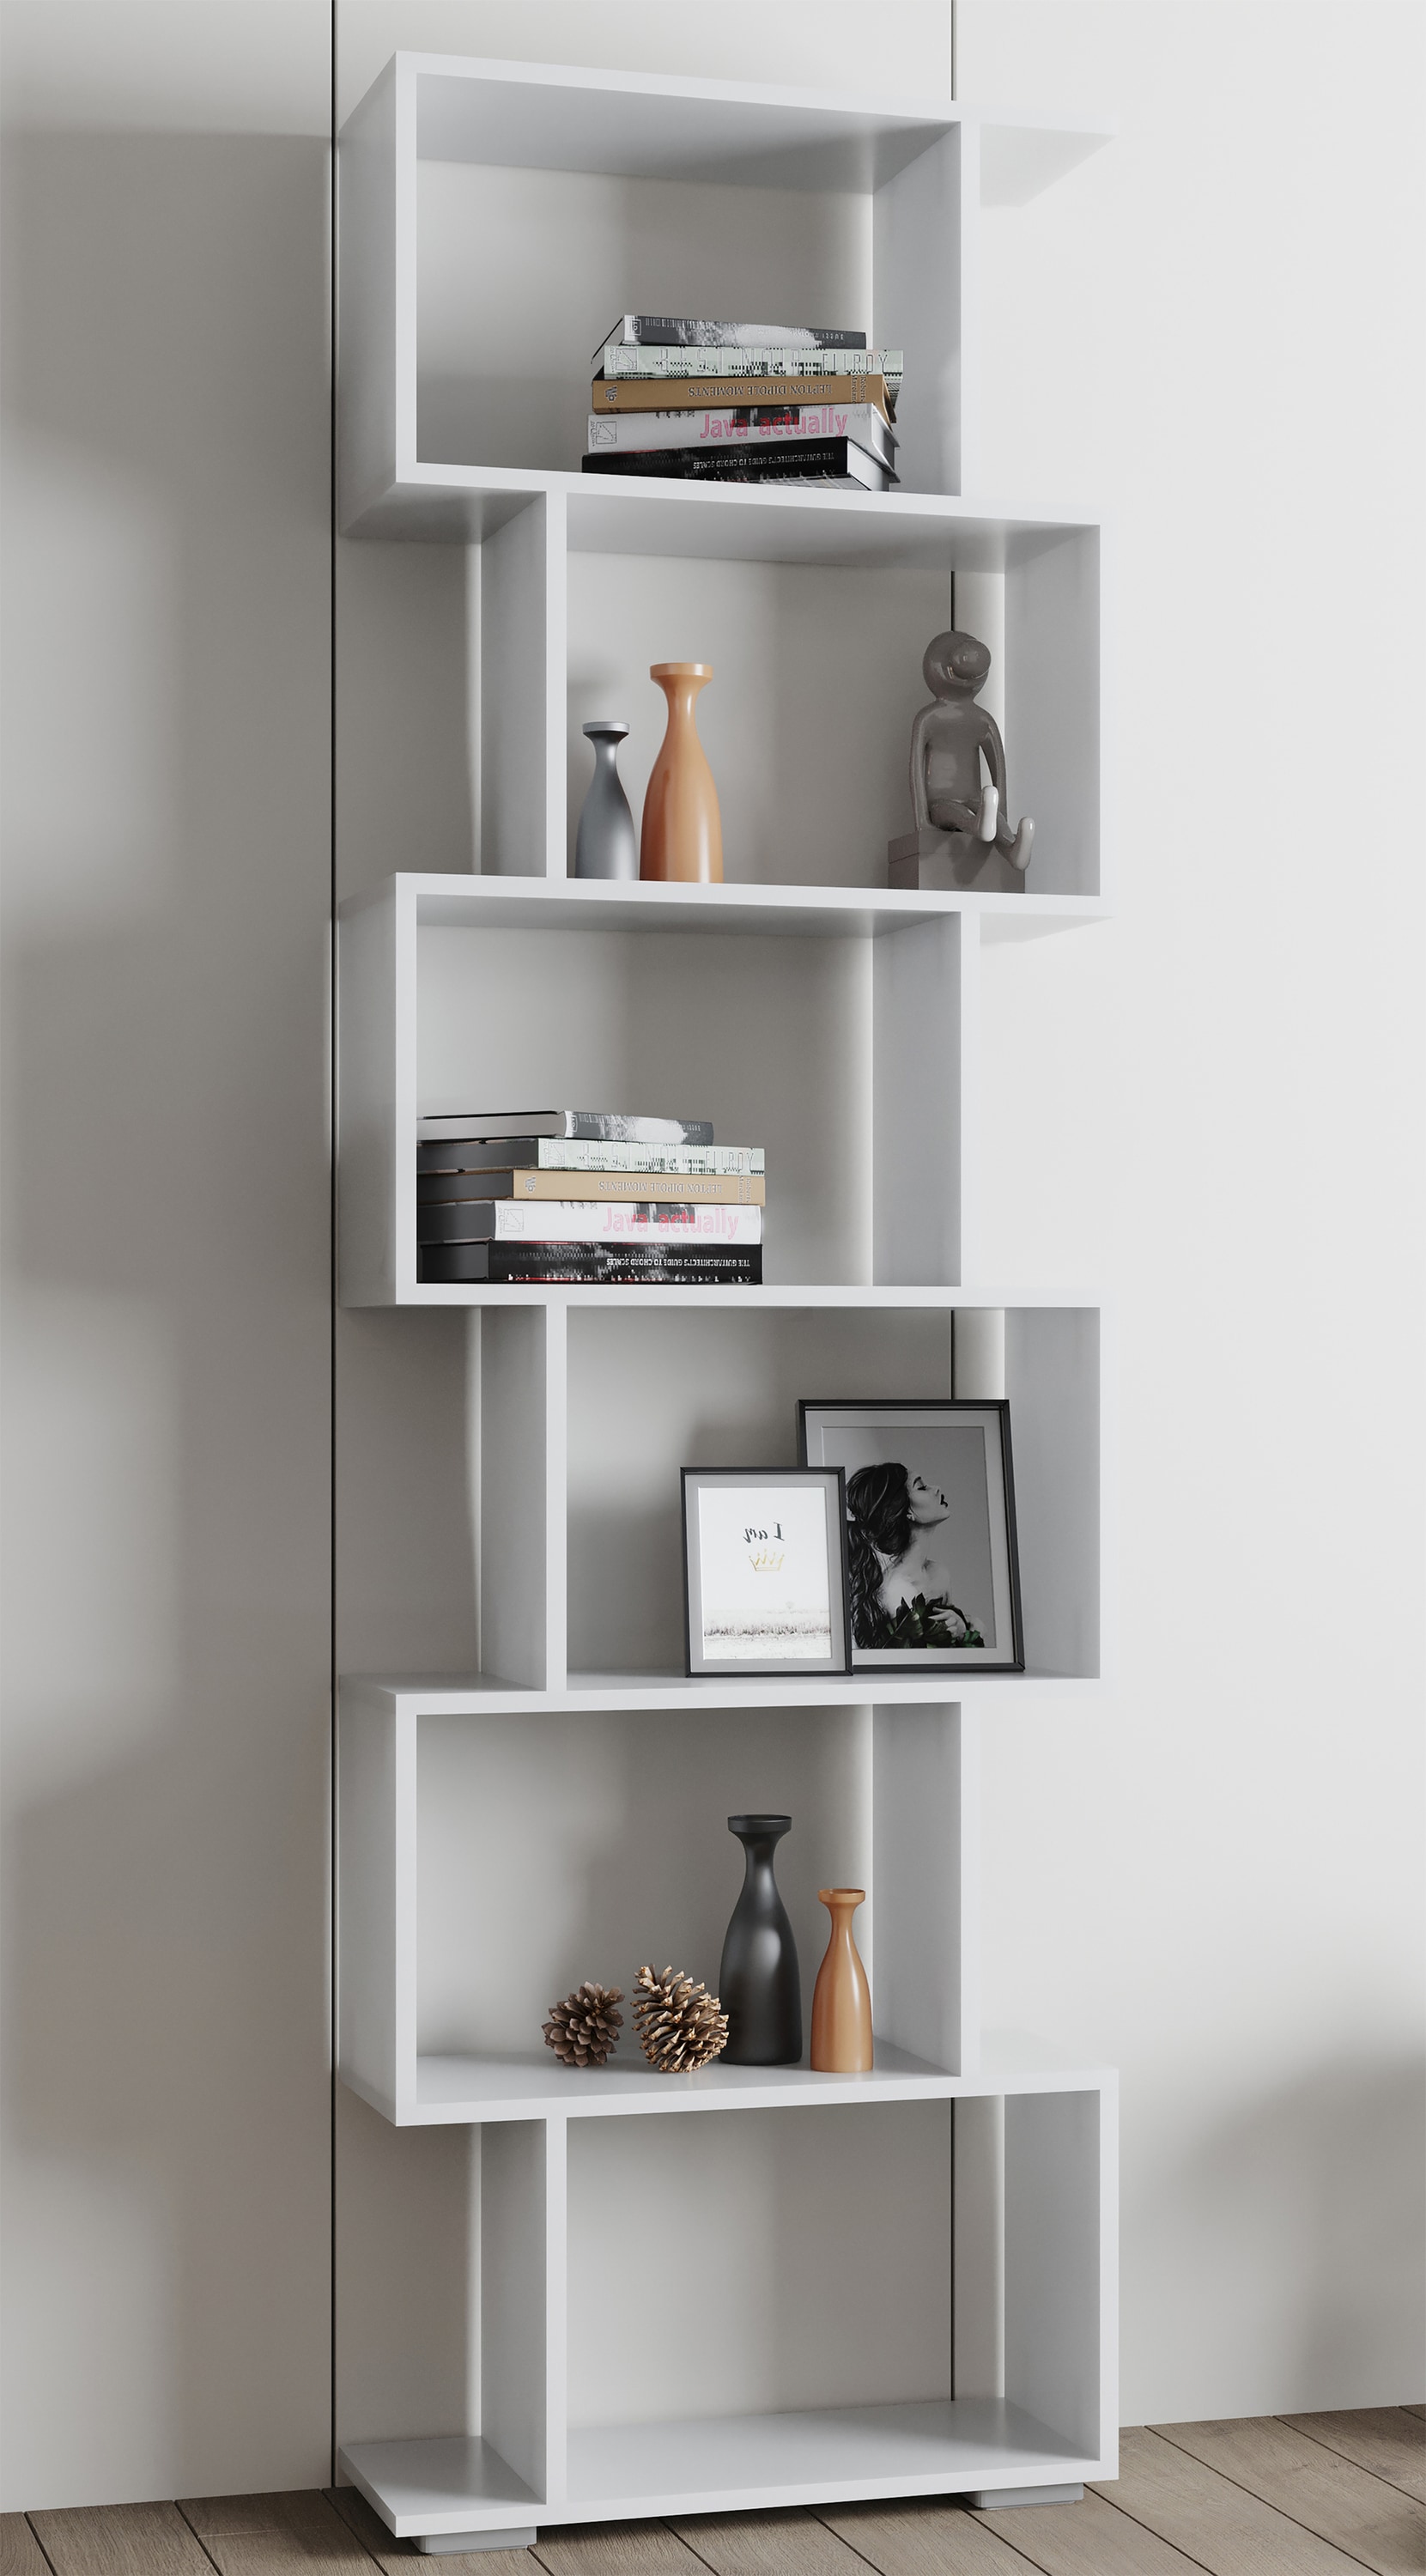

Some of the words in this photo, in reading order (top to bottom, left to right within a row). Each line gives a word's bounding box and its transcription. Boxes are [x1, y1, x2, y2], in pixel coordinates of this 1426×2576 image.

[688, 386, 744, 398] MOMENTS
[747, 385, 786, 397] DIPOLE
[790, 383, 833, 396] LEPTON
[700, 413, 749, 439] Java
[759, 408, 848, 438] actually
[693, 460, 715, 470] SCALES
[598, 1181, 647, 1193] MOMENTS
[649, 1182, 684, 1194] DIPOLE
[687, 1183, 723, 1195] LEPTON
[603, 1207, 648, 1232] Java
[658, 1207, 739, 1239] actually
[606, 1258, 629, 1267] SCALES
[631, 1258, 652, 1267] CHORD
[653, 1258, 662, 1267] TO
[664, 1258, 683, 1267] GUIDE
[738, 1259, 750, 1267] THE
